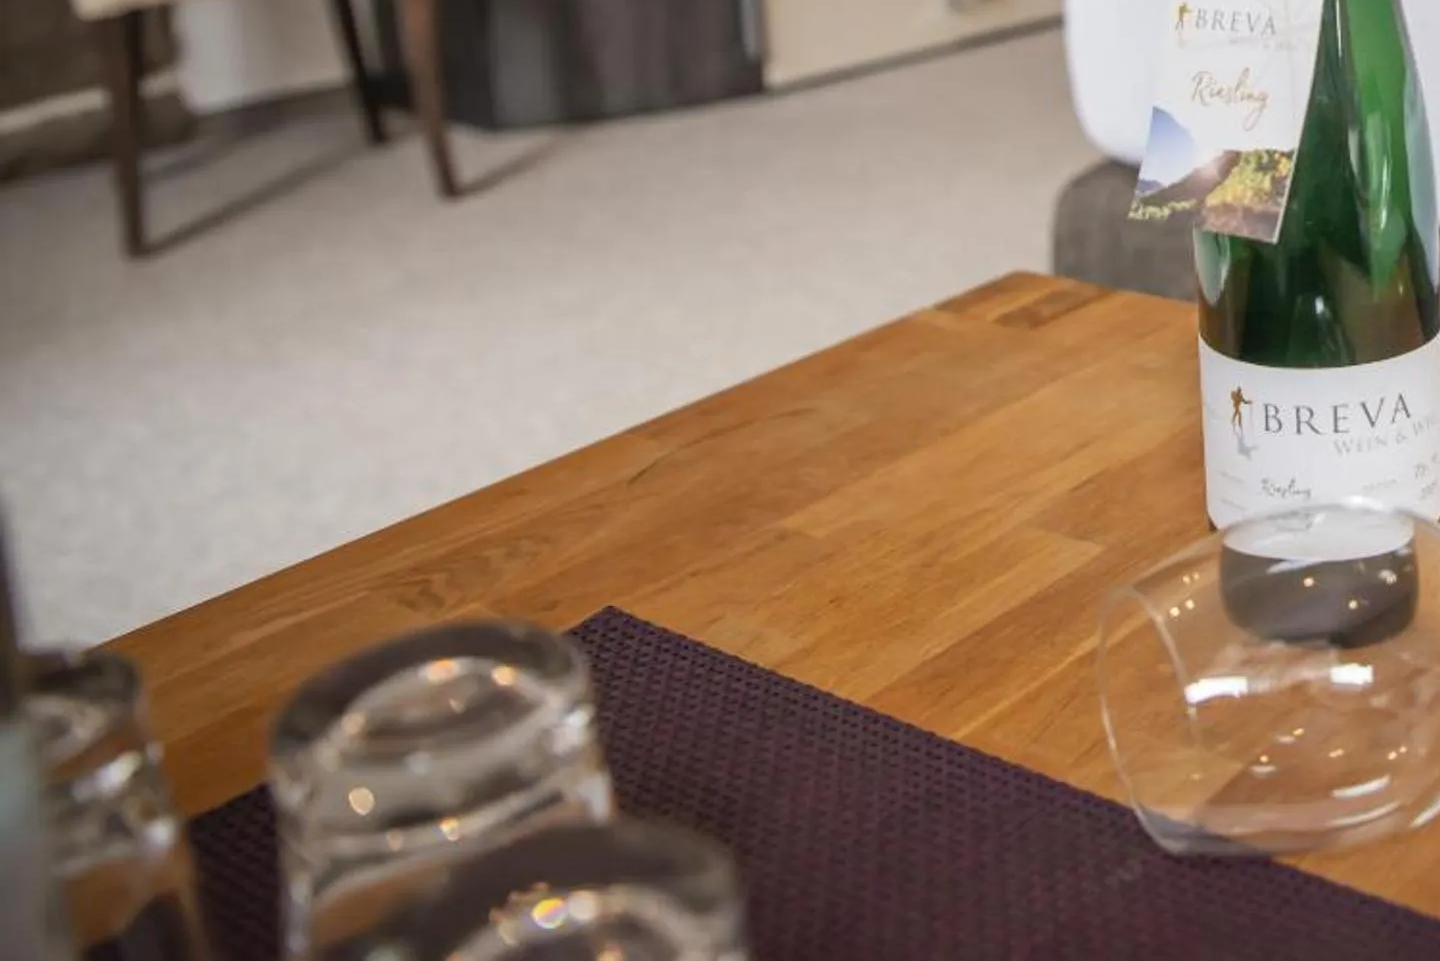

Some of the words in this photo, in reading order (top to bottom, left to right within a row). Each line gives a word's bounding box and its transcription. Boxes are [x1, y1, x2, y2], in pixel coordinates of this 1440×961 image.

[1195, 7, 1276, 36] BREVA
[1191, 67, 1269, 132] Riesling
[1263, 392, 1411, 436] BREVA
